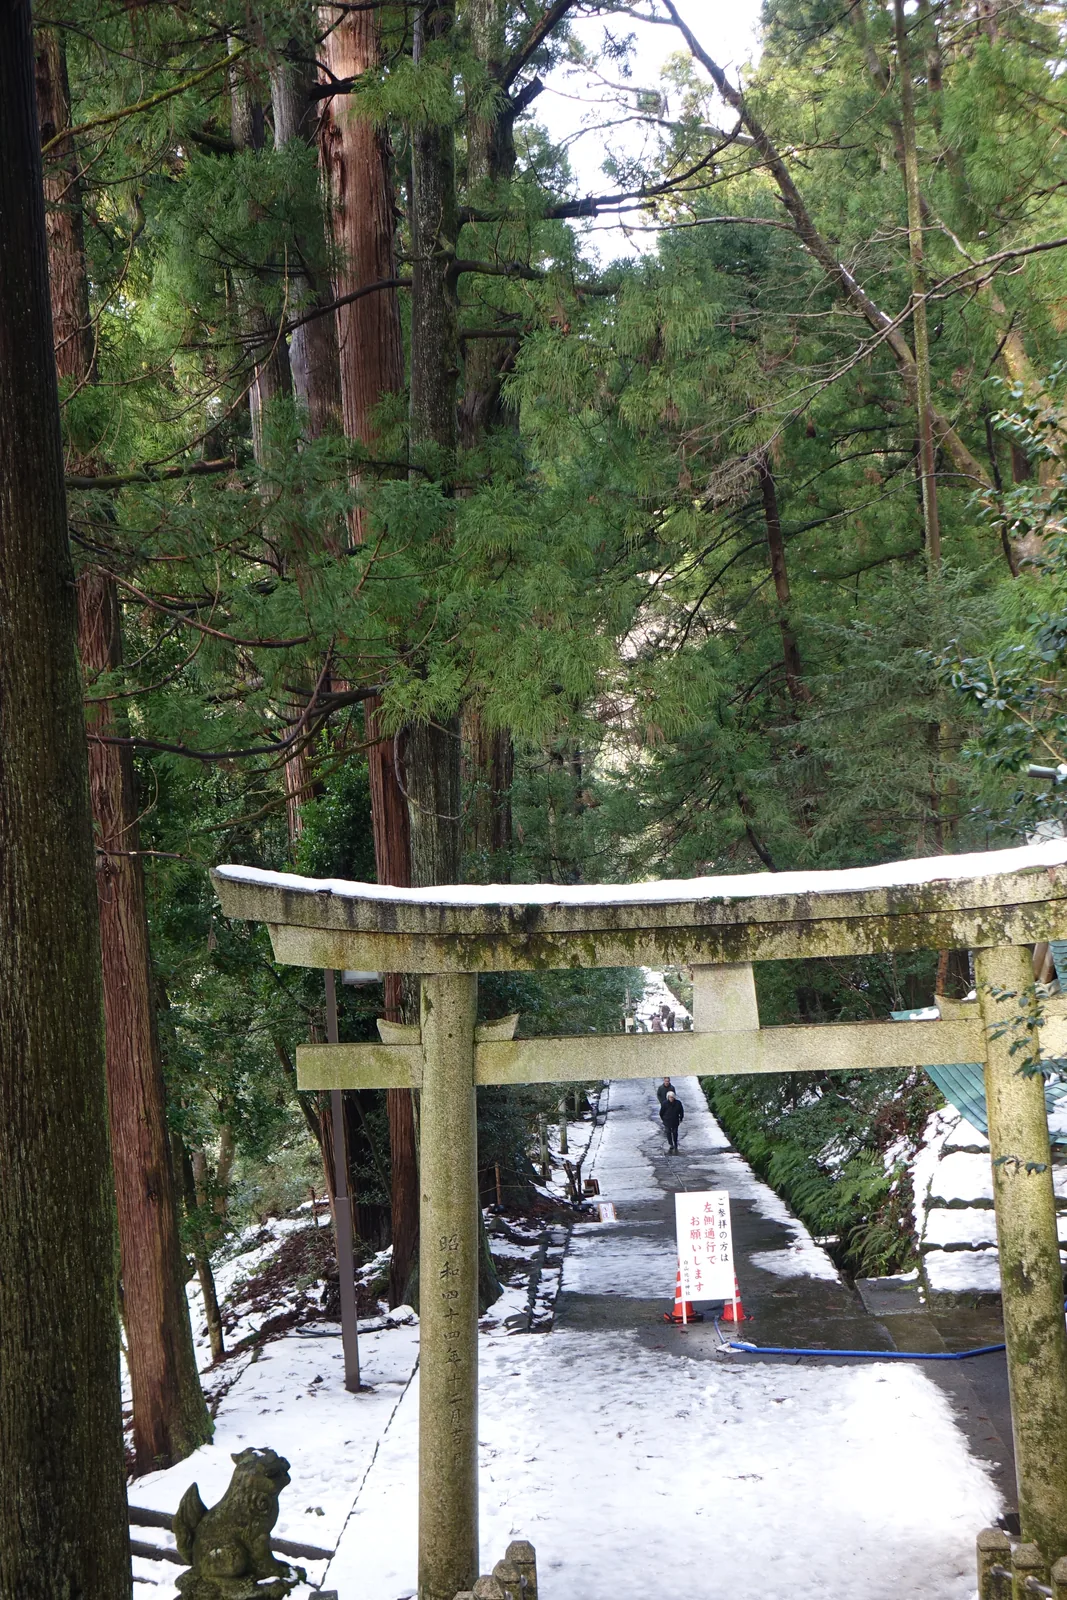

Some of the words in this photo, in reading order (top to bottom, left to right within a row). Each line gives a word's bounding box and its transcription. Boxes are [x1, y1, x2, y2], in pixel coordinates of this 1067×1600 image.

[690, 1216, 704, 1292] お願いします
[703, 1201, 717, 1265] 左側通行で
[718, 1197, 729, 1262] ご参拝の方は
